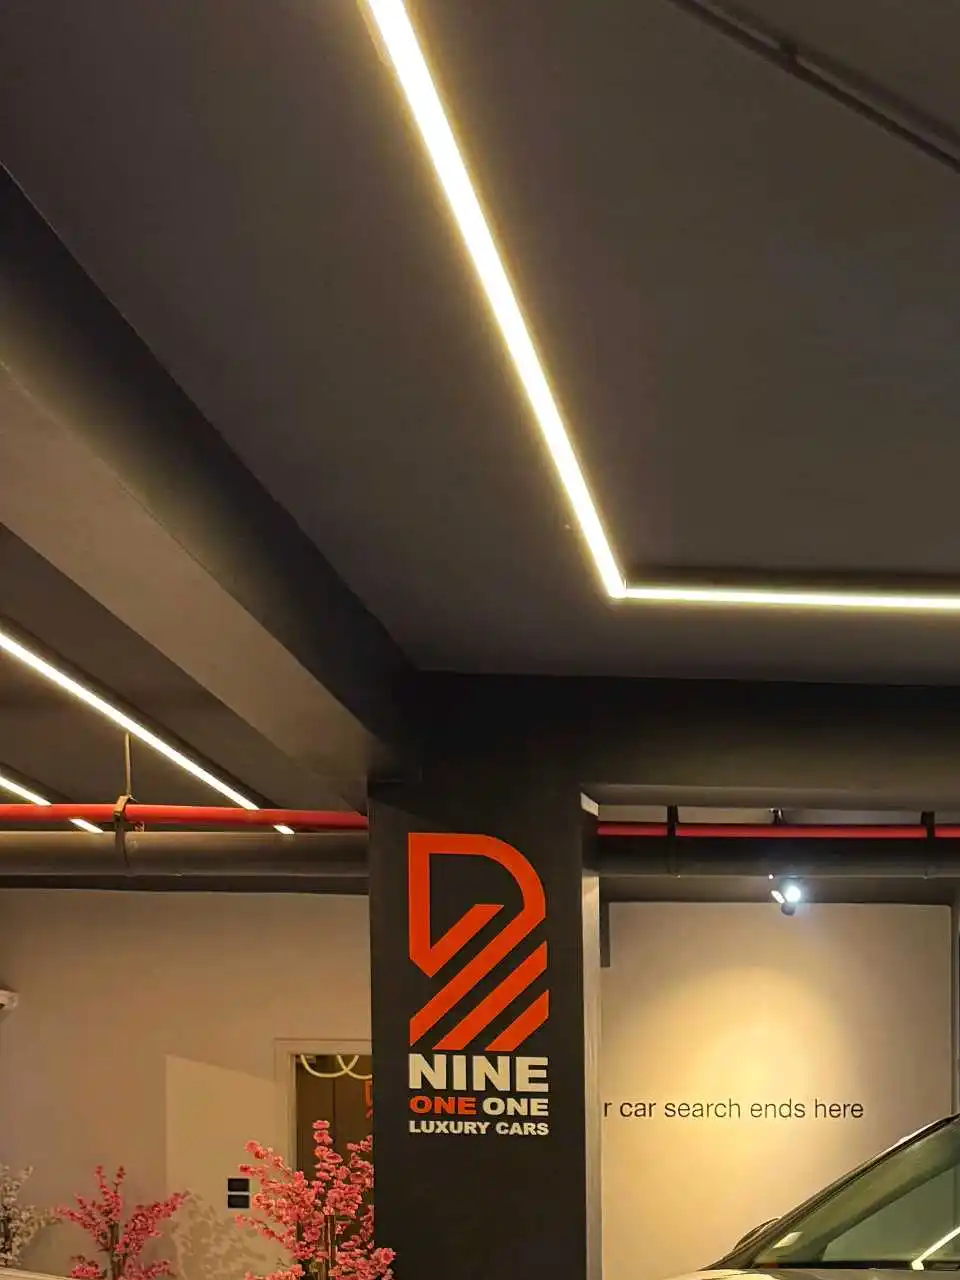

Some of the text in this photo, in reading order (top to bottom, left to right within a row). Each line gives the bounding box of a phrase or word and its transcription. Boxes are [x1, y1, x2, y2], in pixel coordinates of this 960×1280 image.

[408, 1053, 549, 1093] NINE
[408, 1096, 549, 1117] ONE ONE
[619, 1102, 657, 1118] car
[663, 1097, 741, 1119] search
[750, 1097, 806, 1119] ends
[814, 1097, 865, 1119] here
[408, 1120, 549, 1137] LUXURY CARS
